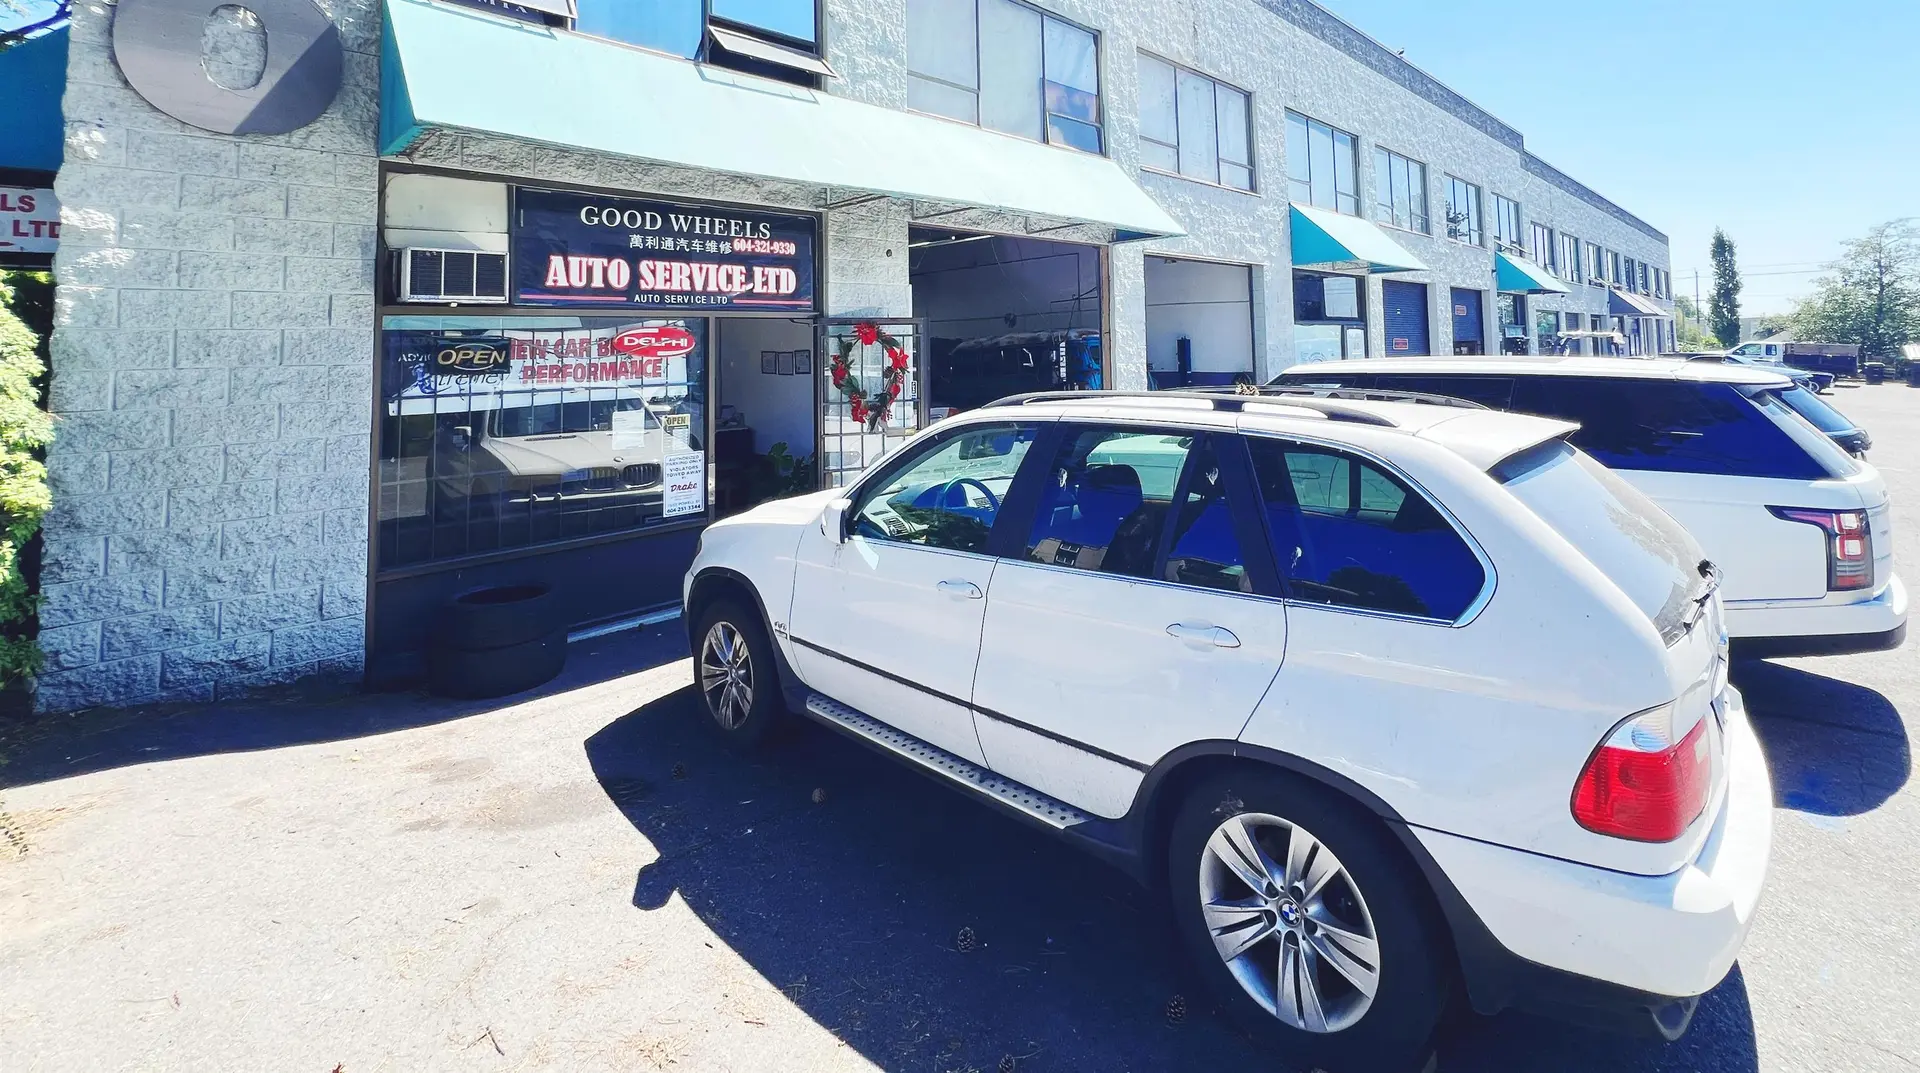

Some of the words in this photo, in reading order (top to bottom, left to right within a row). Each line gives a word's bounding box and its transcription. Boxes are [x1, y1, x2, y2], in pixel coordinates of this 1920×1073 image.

[580, 205, 662, 230] GOOD
[669, 214, 771, 239] WHEELS
[629, 234, 732, 255] 萬利通汽车维修
[733, 238, 796, 256] 604-321-9330
[545, 254, 631, 290] AUTO
[638, 261, 748, 293] SERVICE
[752, 266, 797, 294] LTD
[634, 294, 662, 303] AUTO
[664, 295, 708, 304] SERVICE
[710, 296, 728, 305] LTD
[624, 336, 688, 347] DELPHI
[437, 349, 506, 365] OPEN
[522, 358, 662, 384] PERFORMANCE
[667, 416, 686, 425] OPEN
[670, 481, 697, 492] Drake
